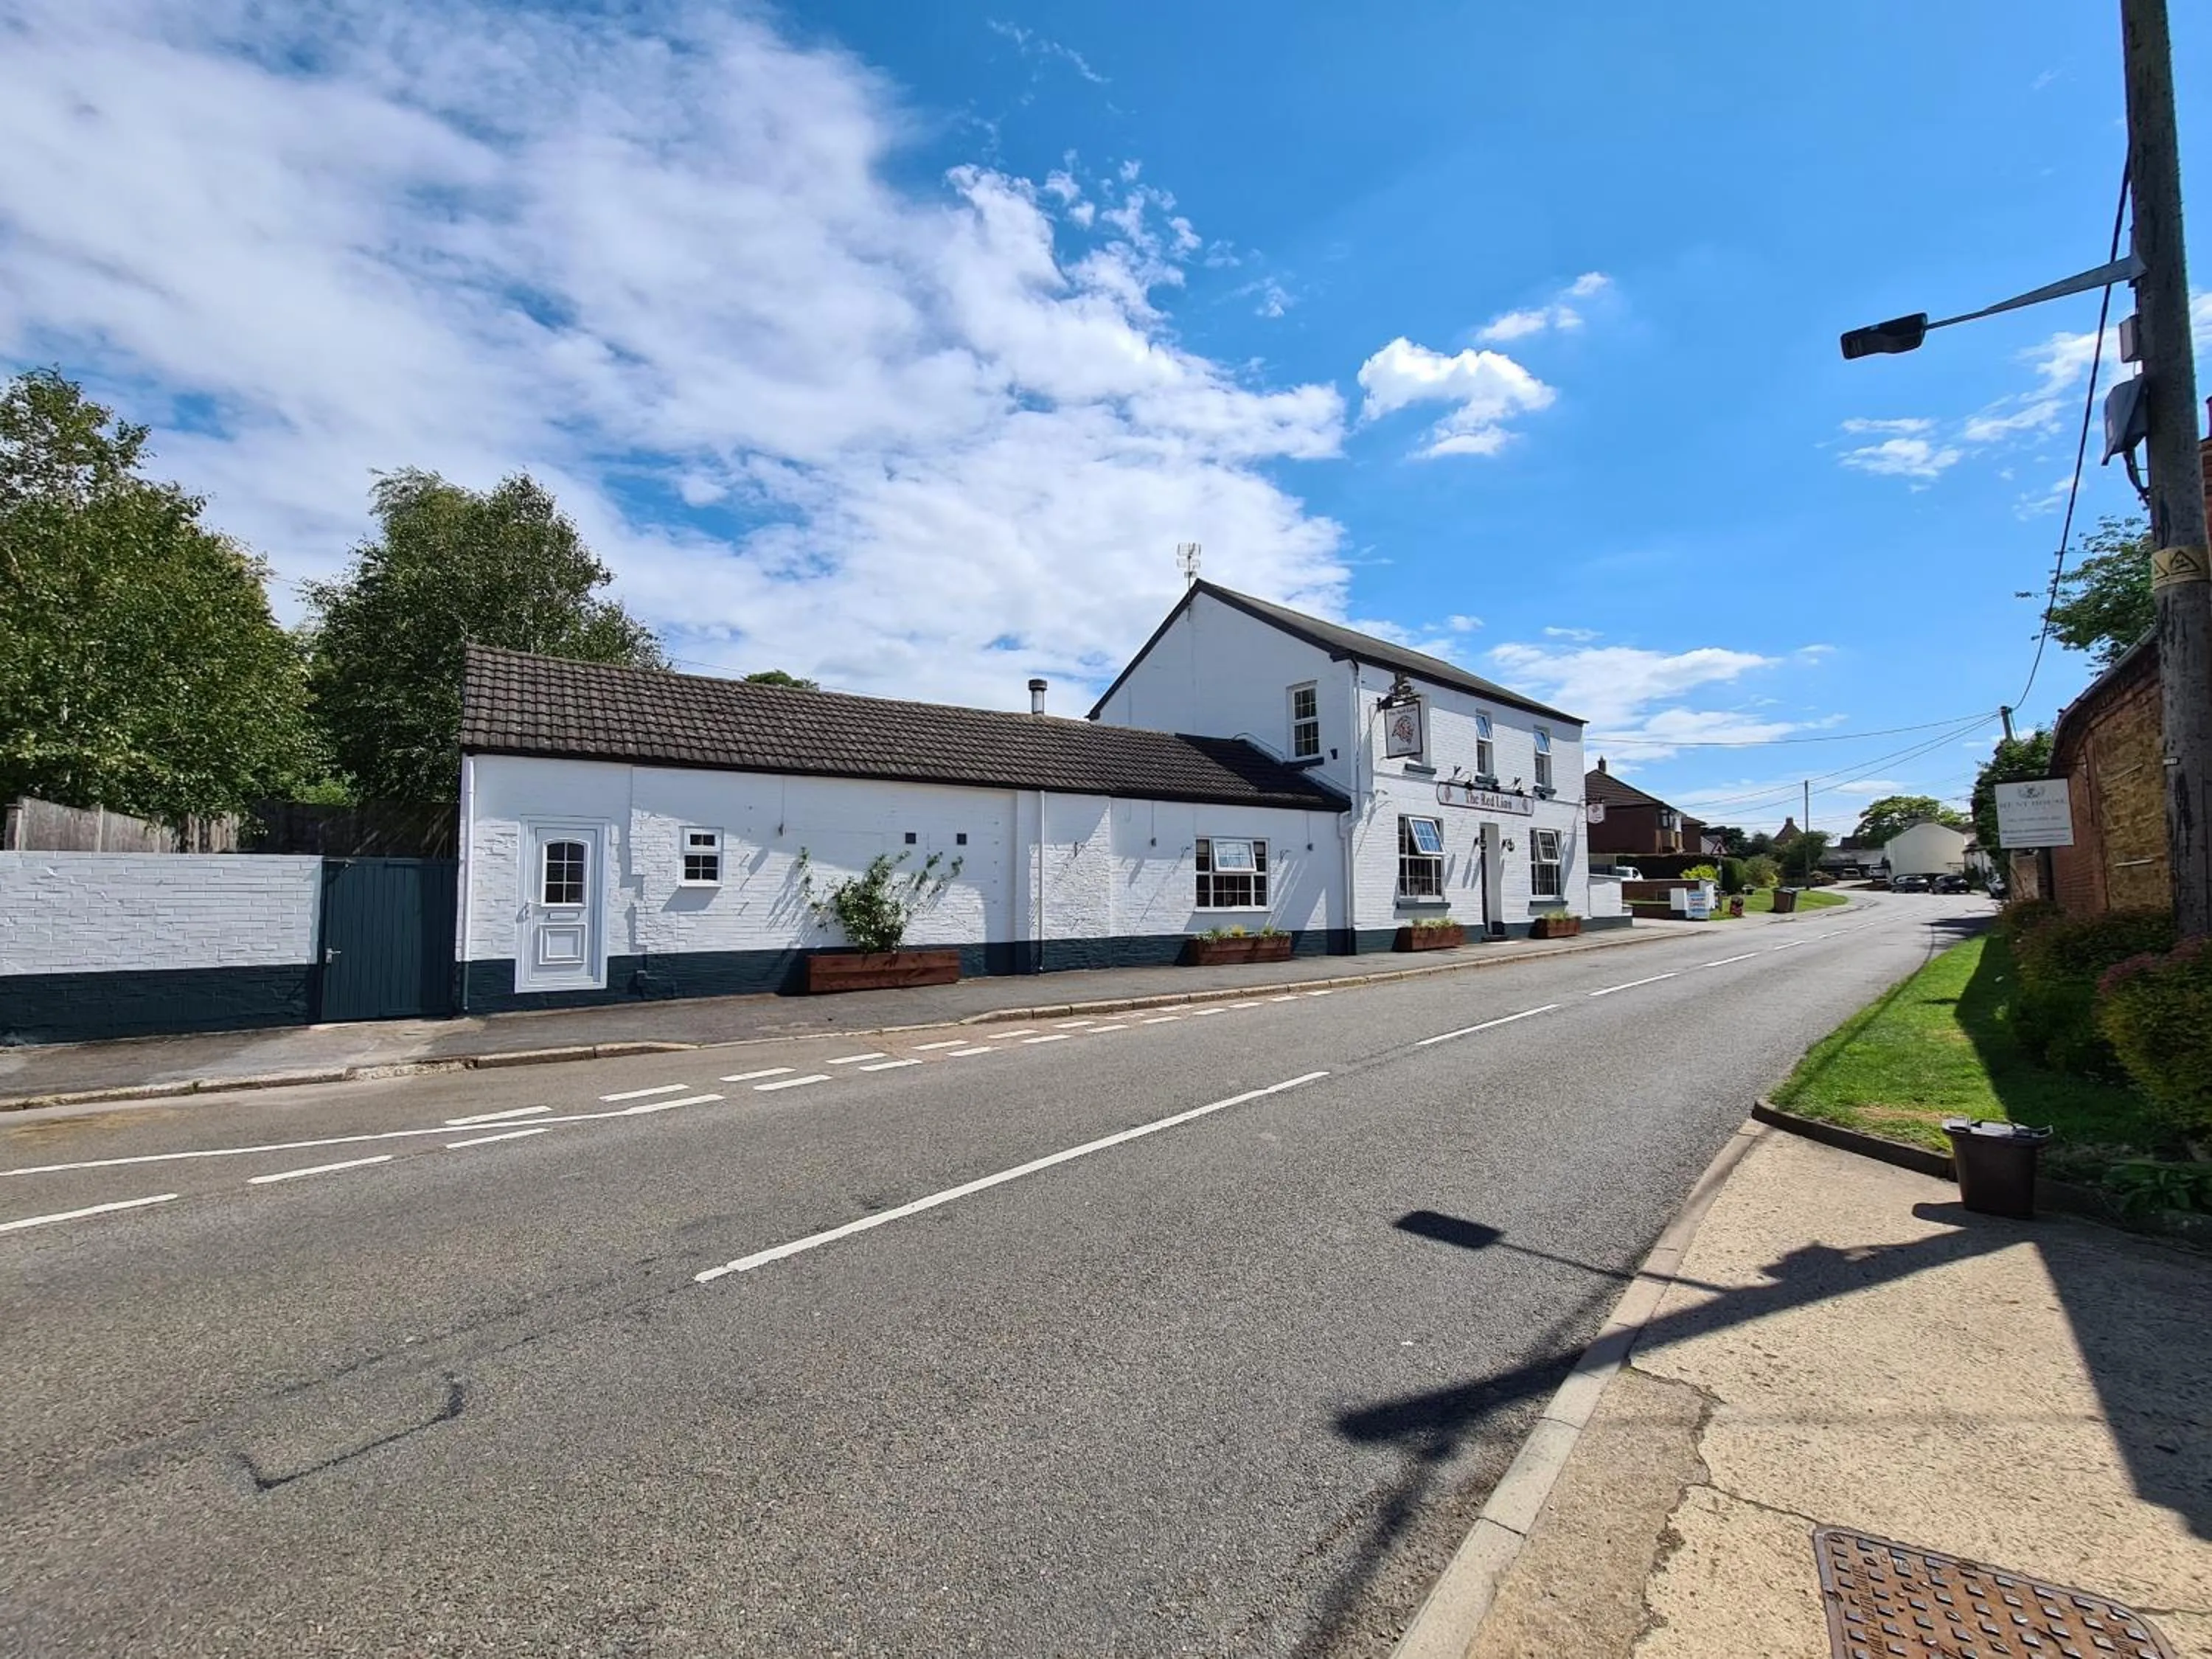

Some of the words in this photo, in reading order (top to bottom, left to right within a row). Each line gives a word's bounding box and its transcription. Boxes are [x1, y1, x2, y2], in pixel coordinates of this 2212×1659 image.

[1464, 790, 1479, 805] The
[1481, 792, 1495, 807] Red
[1495, 794, 1512, 810] Lion
